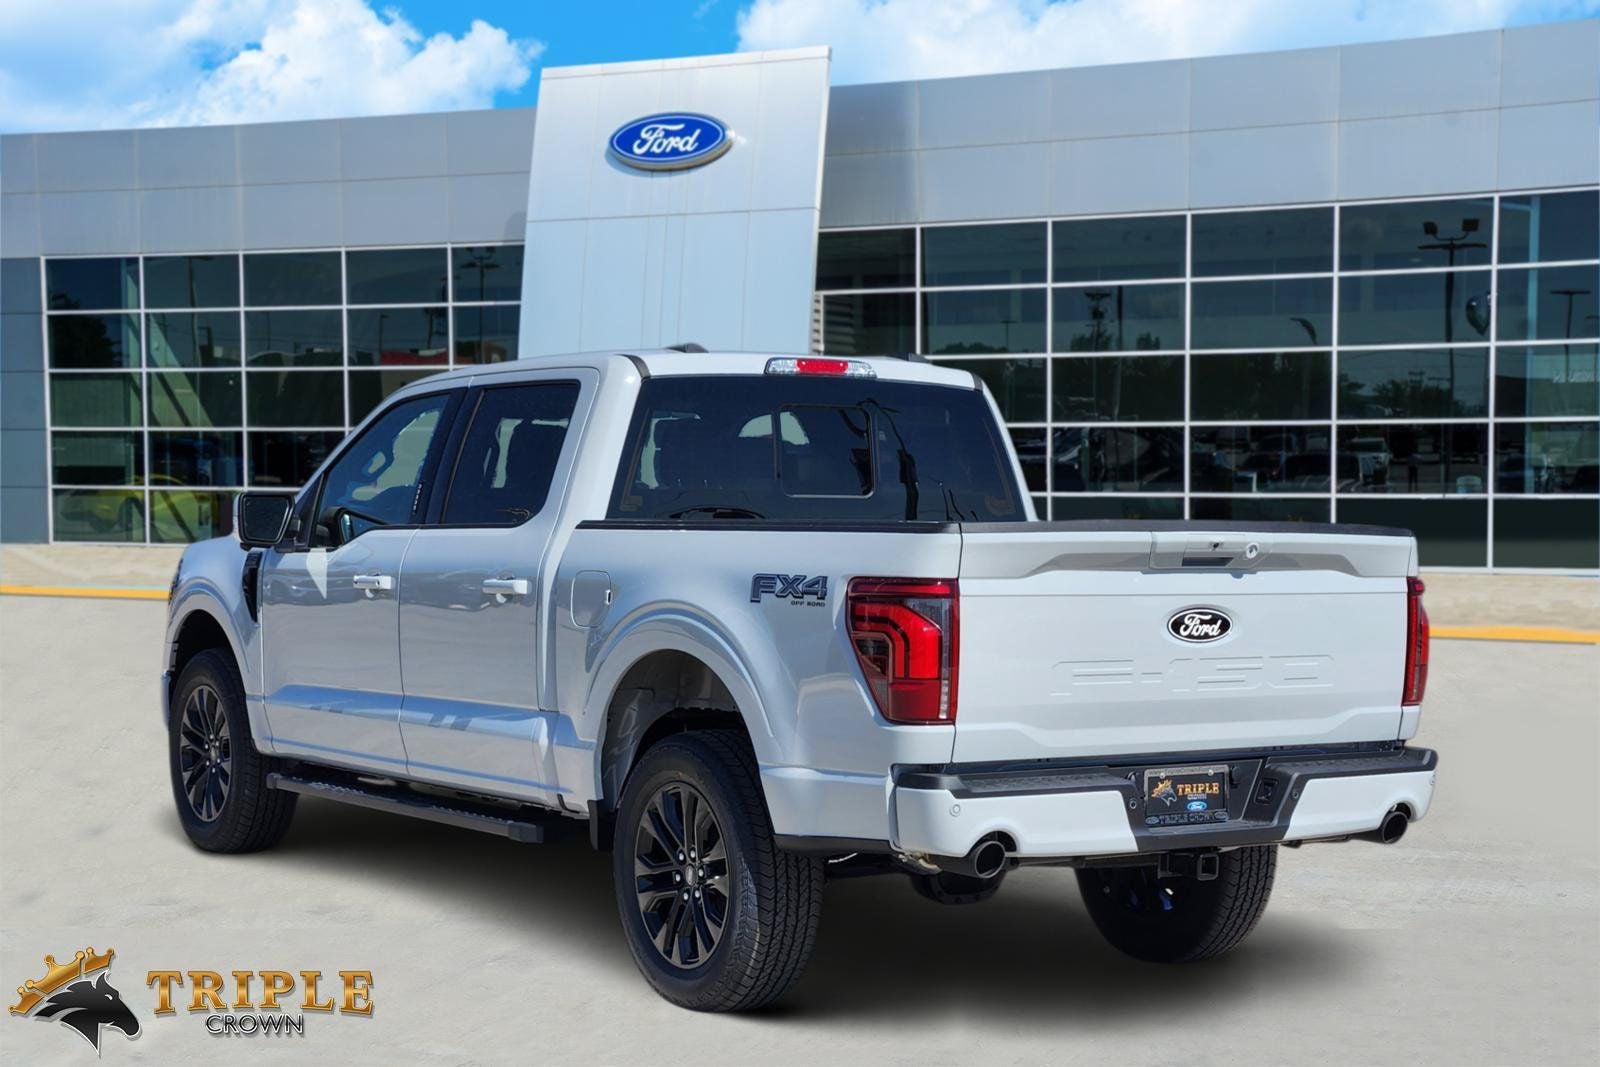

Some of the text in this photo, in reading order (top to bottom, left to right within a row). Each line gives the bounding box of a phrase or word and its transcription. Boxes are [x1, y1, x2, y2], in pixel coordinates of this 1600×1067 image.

[632, 123, 701, 155] Ford
[750, 573, 828, 603] FX4
[1179, 613, 1222, 637] Ford
[1050, 655, 1335, 696] F-150
[1177, 782, 1219, 795] TRIPLE
